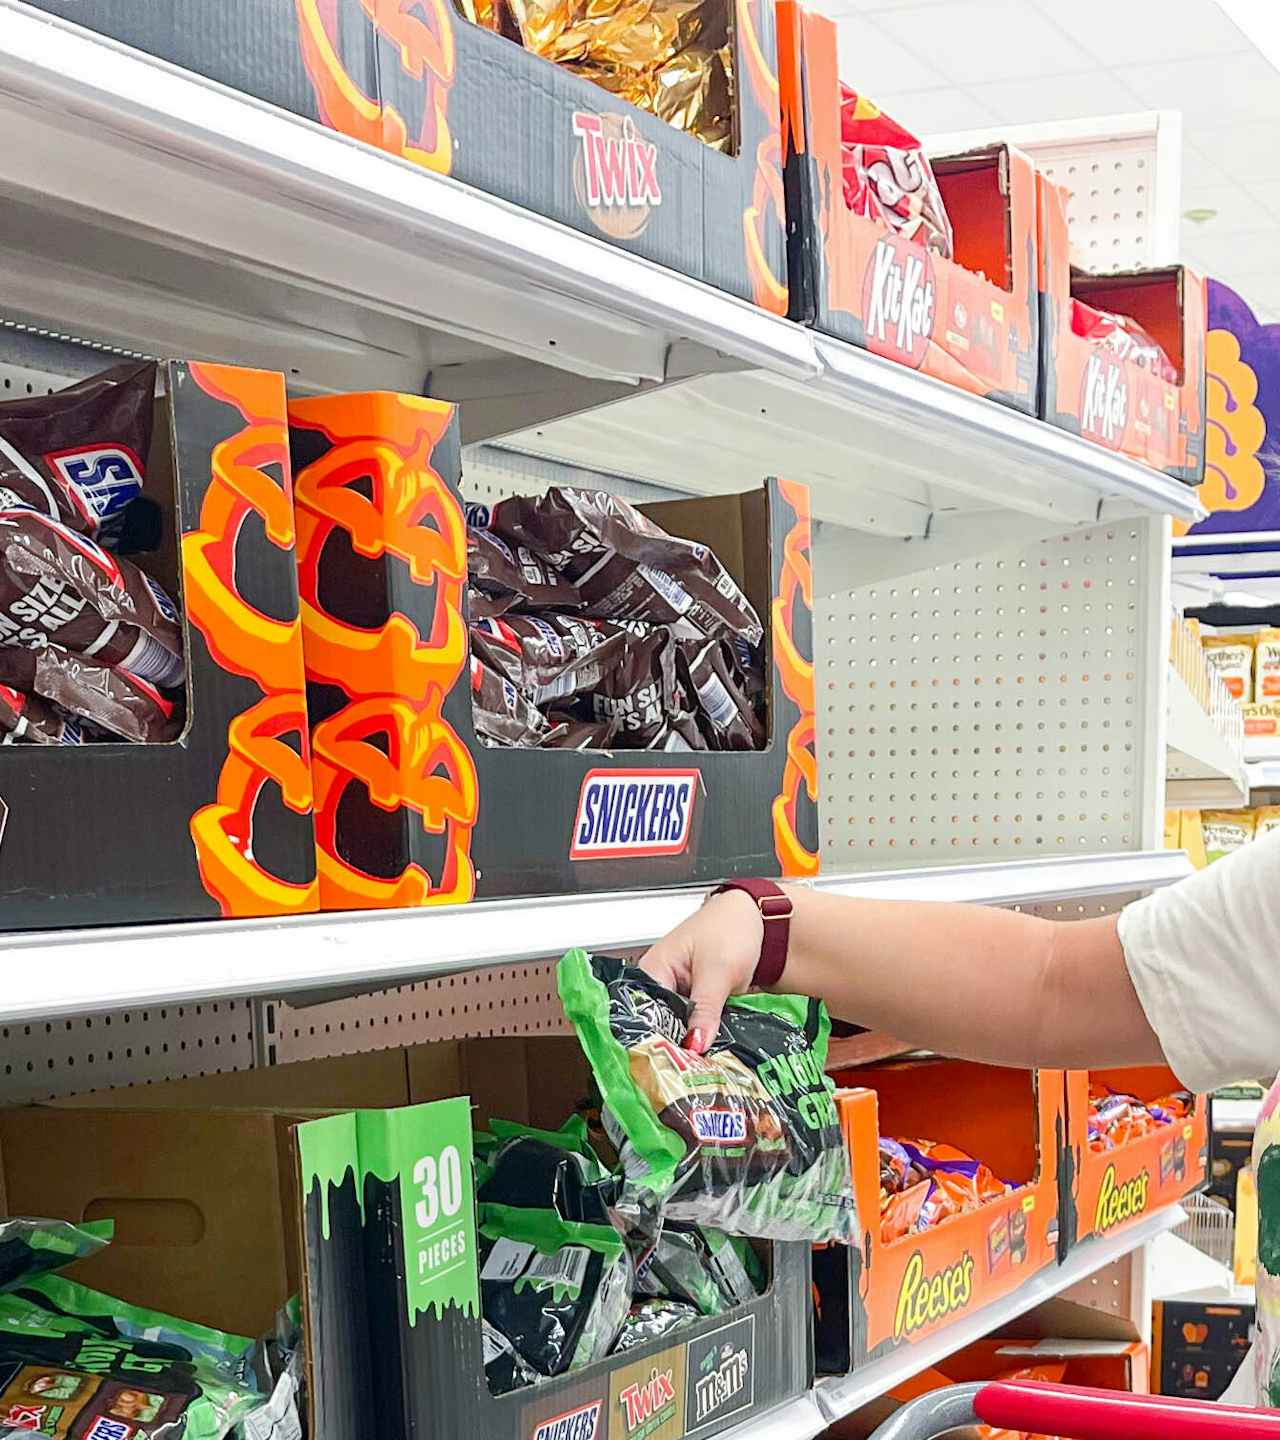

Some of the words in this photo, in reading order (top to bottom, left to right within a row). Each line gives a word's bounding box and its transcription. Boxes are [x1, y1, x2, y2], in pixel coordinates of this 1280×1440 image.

[571, 111, 661, 206] Twix
[9, 573, 69, 622] SIZE
[39, 592, 88, 632] ALL
[578, 783, 690, 847] SNICKERS
[412, 1145, 462, 1229] 30
[1095, 1163, 1149, 1233] Reese's
[418, 1231, 466, 1274] PIECES
[894, 1250, 974, 1344] Reese's
[619, 1367, 676, 1432] Twix
